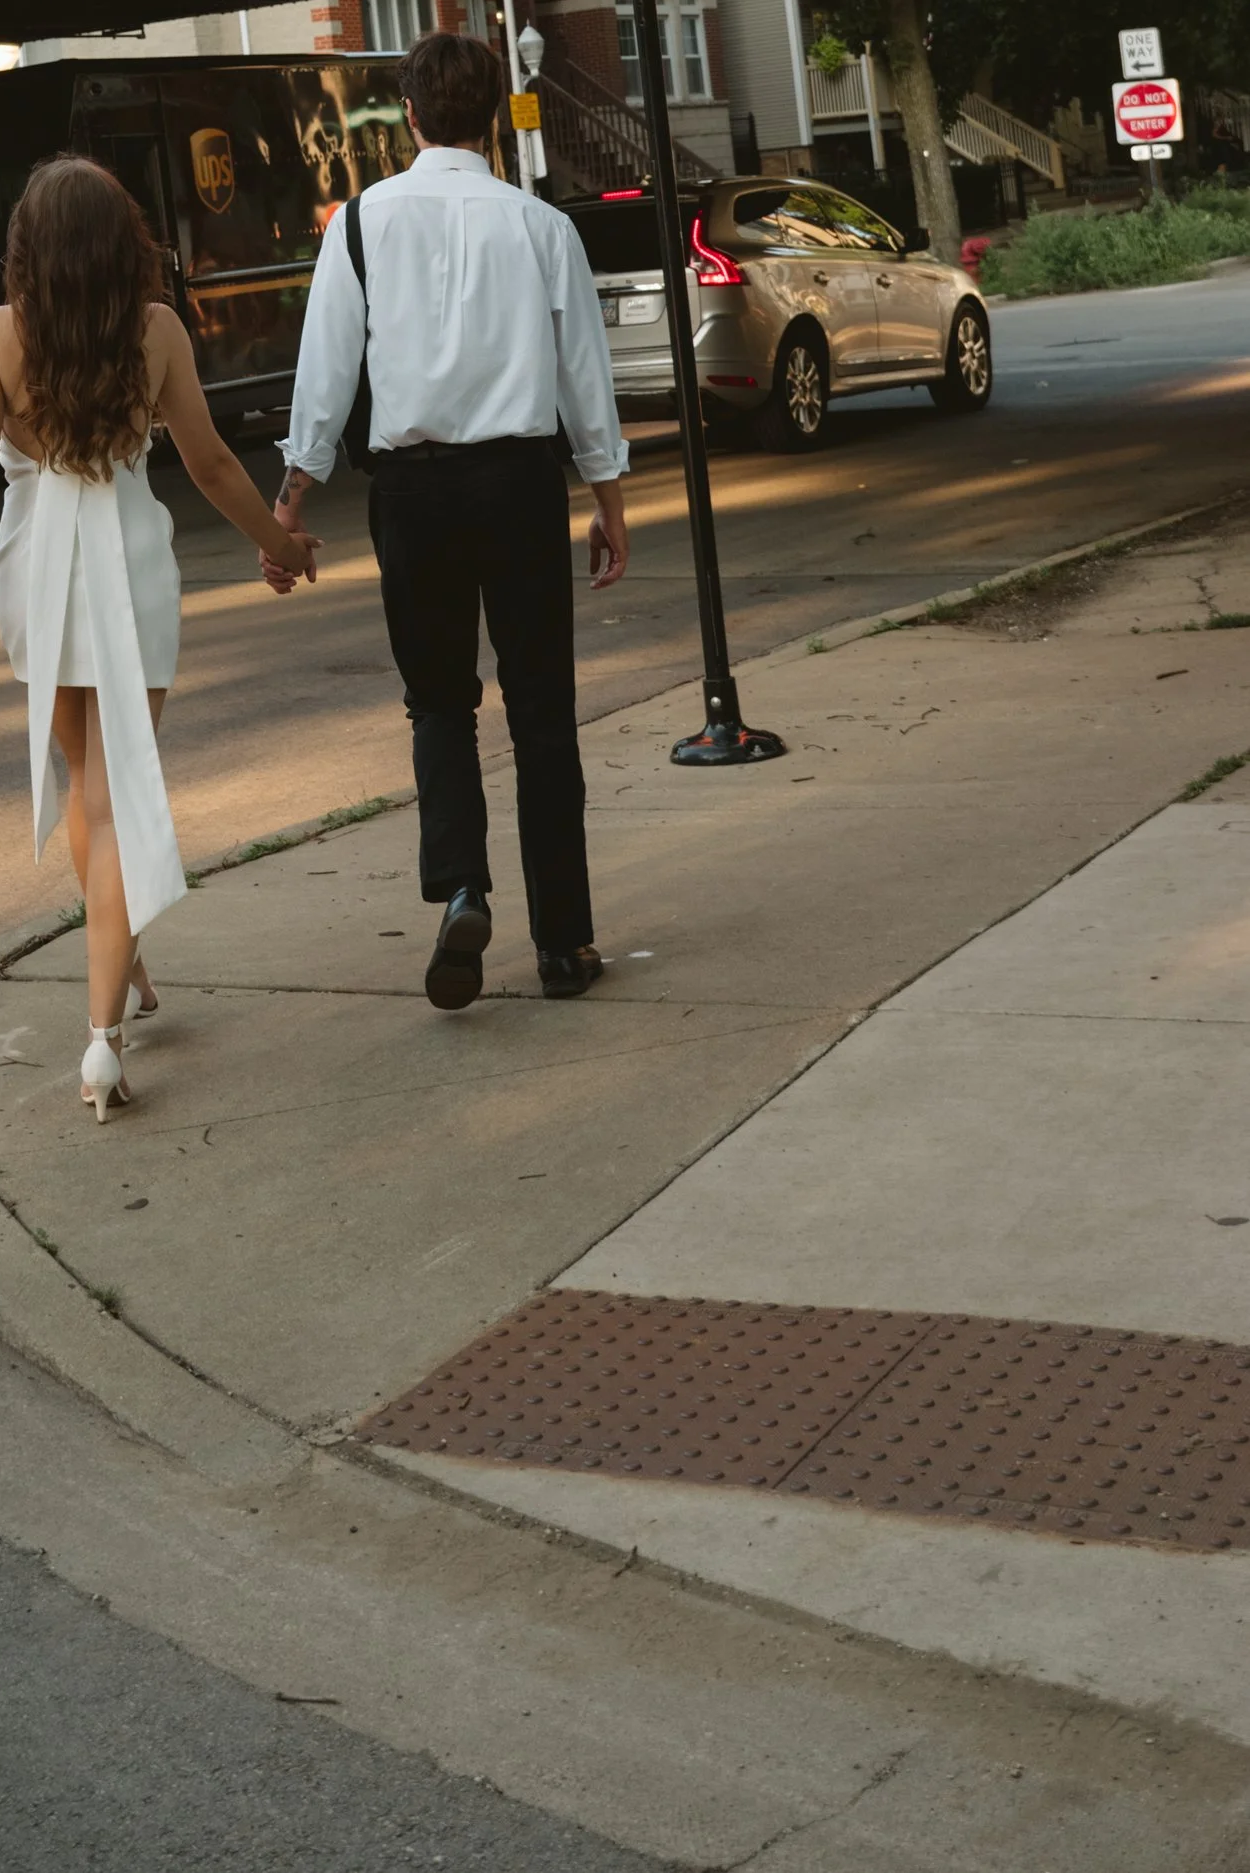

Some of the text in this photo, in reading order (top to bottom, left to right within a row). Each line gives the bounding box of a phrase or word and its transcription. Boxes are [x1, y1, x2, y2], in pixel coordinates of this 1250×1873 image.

[1125, 33, 1153, 46] ONE
[1125, 46, 1154, 59] WAY
[1123, 91, 1168, 106] DO NOT
[1130, 118, 1167, 131] ENTER
[195, 153, 232, 201] ups
